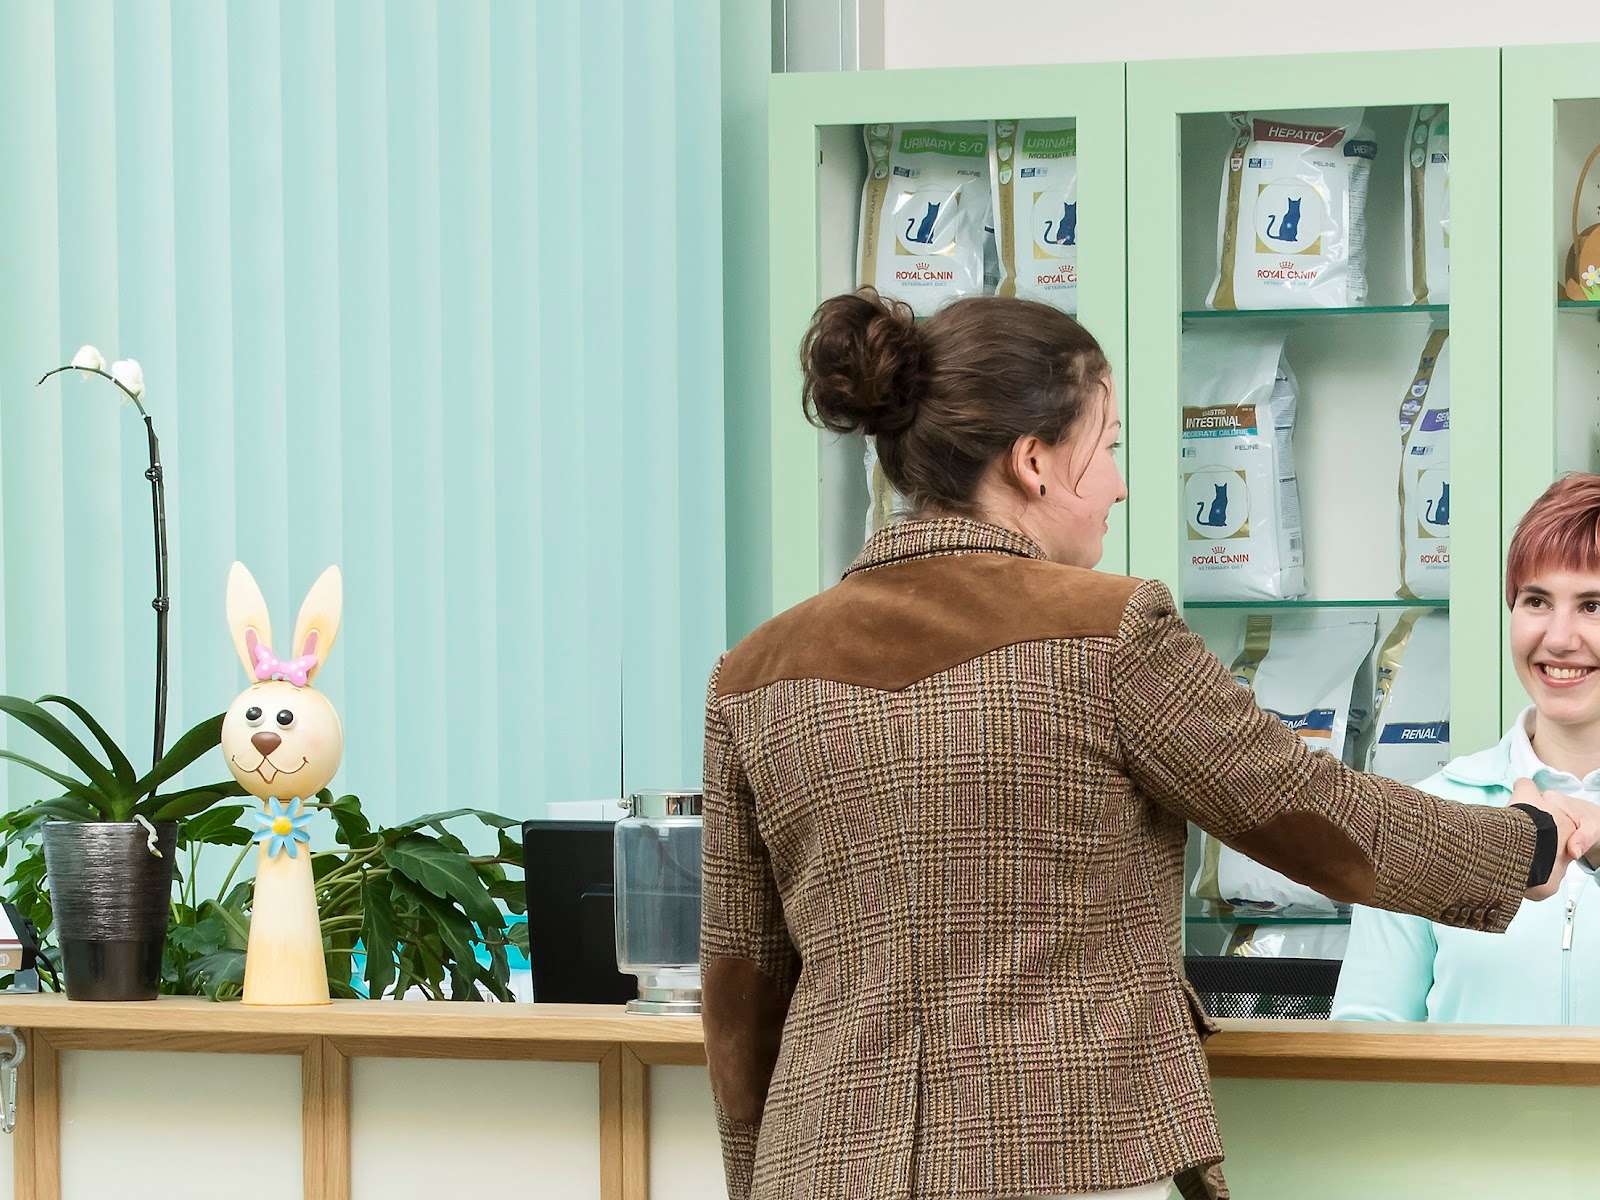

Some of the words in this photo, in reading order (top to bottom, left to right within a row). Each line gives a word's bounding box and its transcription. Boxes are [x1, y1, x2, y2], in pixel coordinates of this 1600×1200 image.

[1268, 126, 1325, 142] HEPATIC
[895, 271, 920, 280] ROYAL
[923, 271, 953, 280] CANIN
[1037, 275, 1065, 285] ROYAL
[1257, 269, 1285, 279] ROYAL
[1287, 270, 1318, 280] CANIN
[1186, 415, 1242, 429] INTESTINAL
[1191, 555, 1218, 564] ROYAL
[1220, 553, 1249, 563] CANIN
[1420, 554, 1444, 564] ROYAL
[1401, 727, 1437, 740] RENAL
